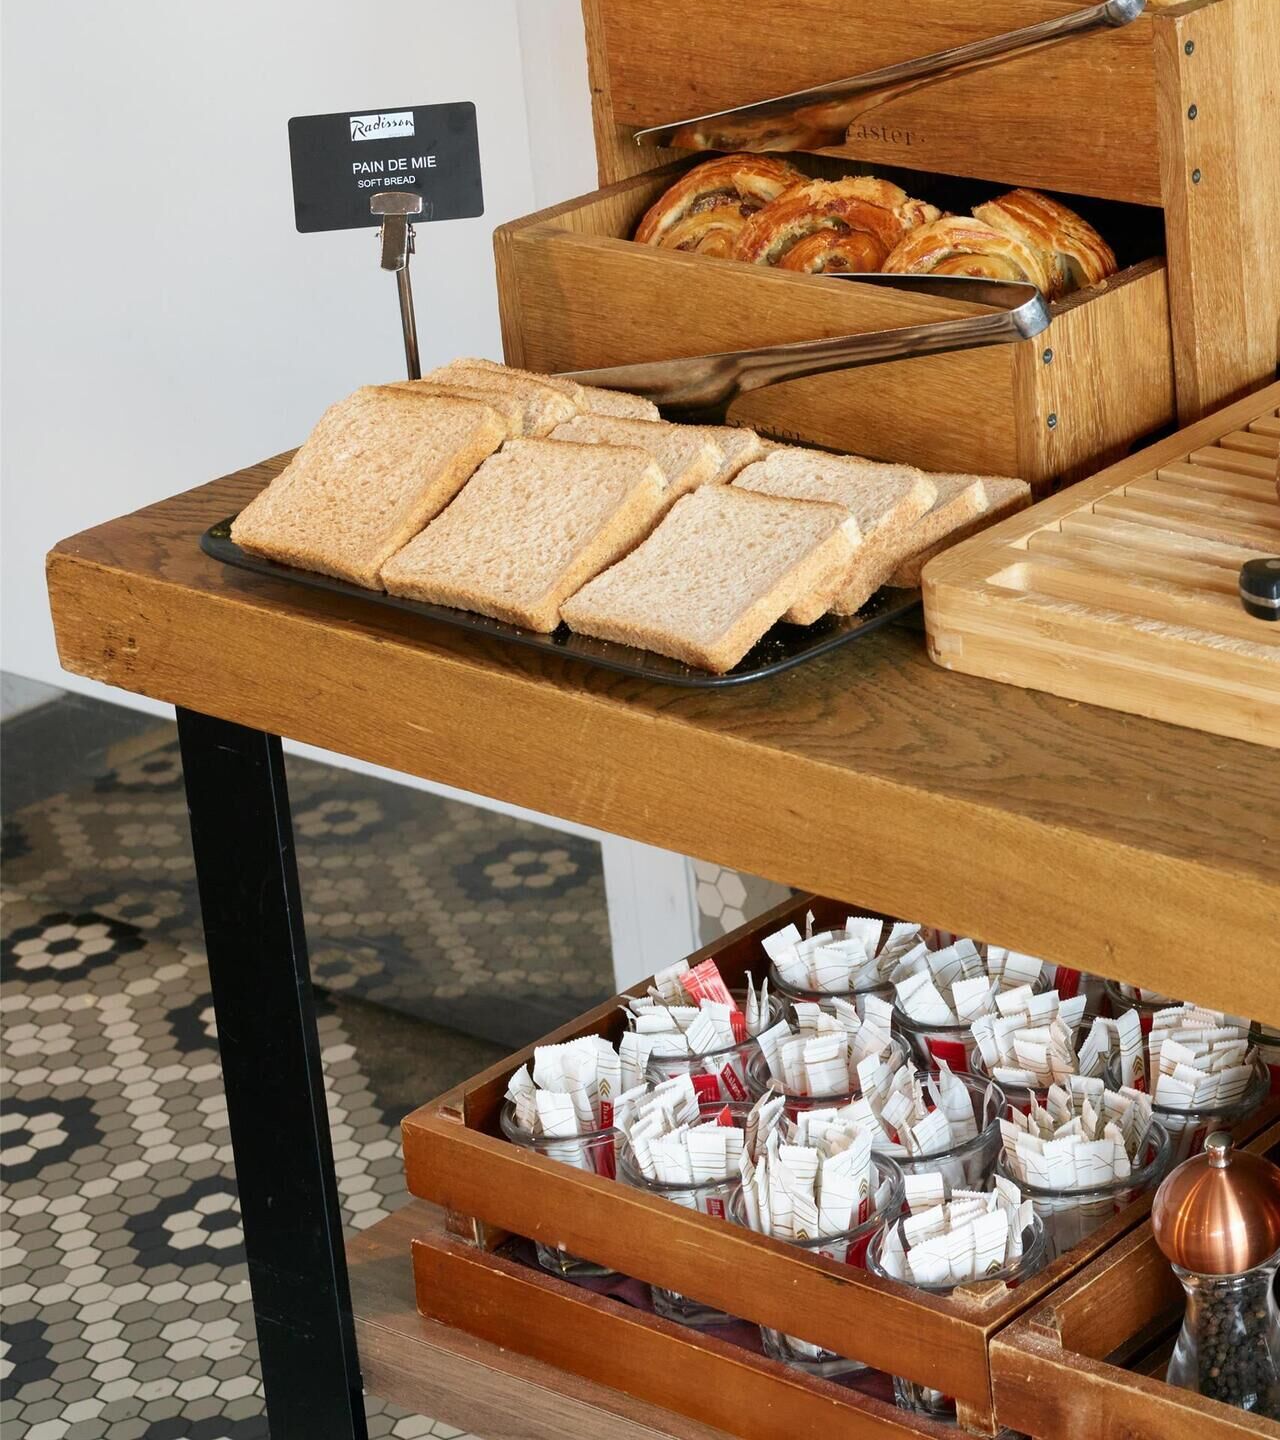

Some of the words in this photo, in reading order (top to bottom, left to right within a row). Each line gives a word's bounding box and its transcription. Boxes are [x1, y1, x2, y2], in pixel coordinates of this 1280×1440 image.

[351, 115, 415, 140] Radisson
[352, 159, 384, 174] PAIN
[388, 158, 407, 172] DE
[411, 155, 437, 169] MIE
[357, 178, 382, 189] SOFT
[384, 175, 416, 186] BREAD
